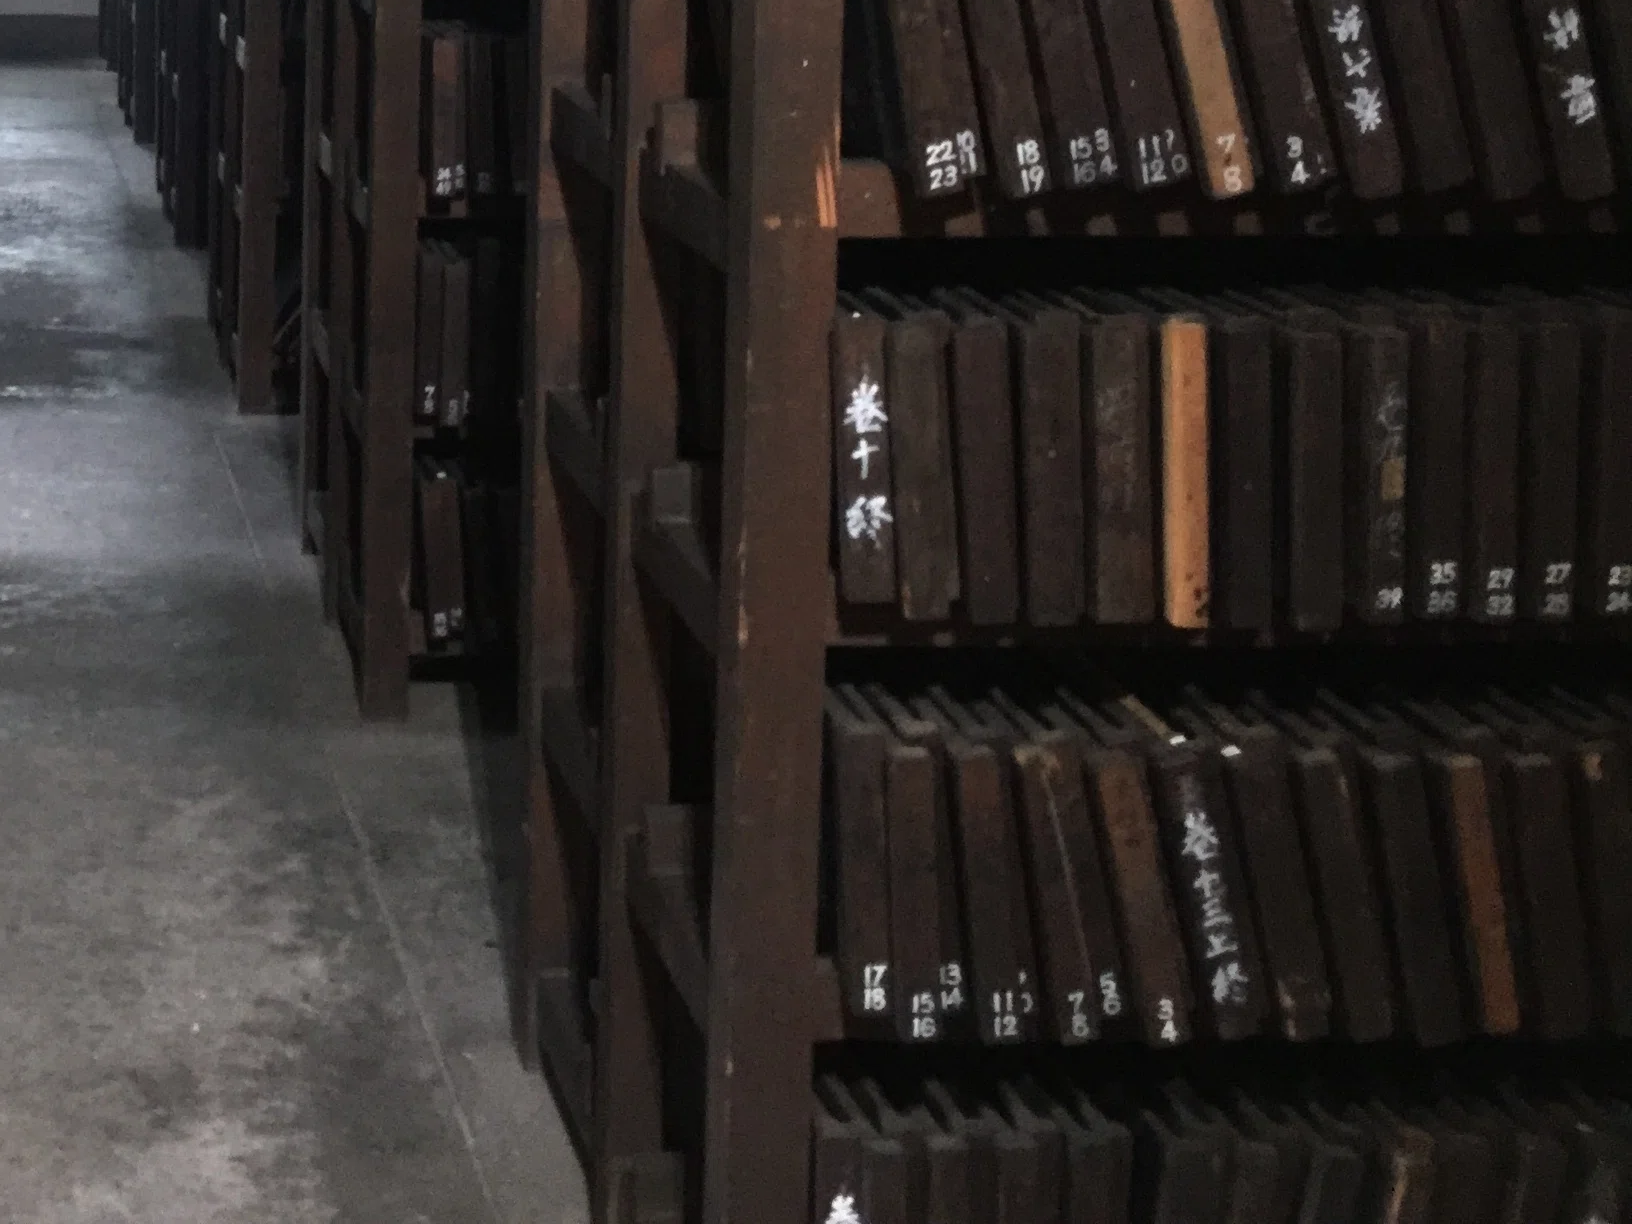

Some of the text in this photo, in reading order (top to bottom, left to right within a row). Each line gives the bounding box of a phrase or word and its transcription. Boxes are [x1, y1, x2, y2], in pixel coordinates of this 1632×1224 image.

[926, 140, 956, 169] 22
[1015, 139, 1040, 166] 18
[1069, 136, 1092, 160] 15
[1138, 135, 1161, 161] 11
[1216, 132, 1236, 153] 7
[1286, 135, 1303, 159] 3
[927, 163, 958, 190] 23
[1020, 163, 1045, 193] 19
[1072, 159, 1097, 184] 16
[1141, 157, 1167, 185] 12
[1222, 164, 1243, 192] 8
[1291, 160, 1310, 184] 4
[864, 964, 888, 989] 17
[863, 986, 887, 1011] 18
[912, 992, 935, 1014] 15
[992, 991, 1013, 1013] 11
[1067, 991, 1085, 1015] 7
[1158, 998, 1174, 1022] 3
[912, 1016, 936, 1038] 16
[993, 1013, 1017, 1037] 12
[1161, 1018, 1178, 1042] 4
